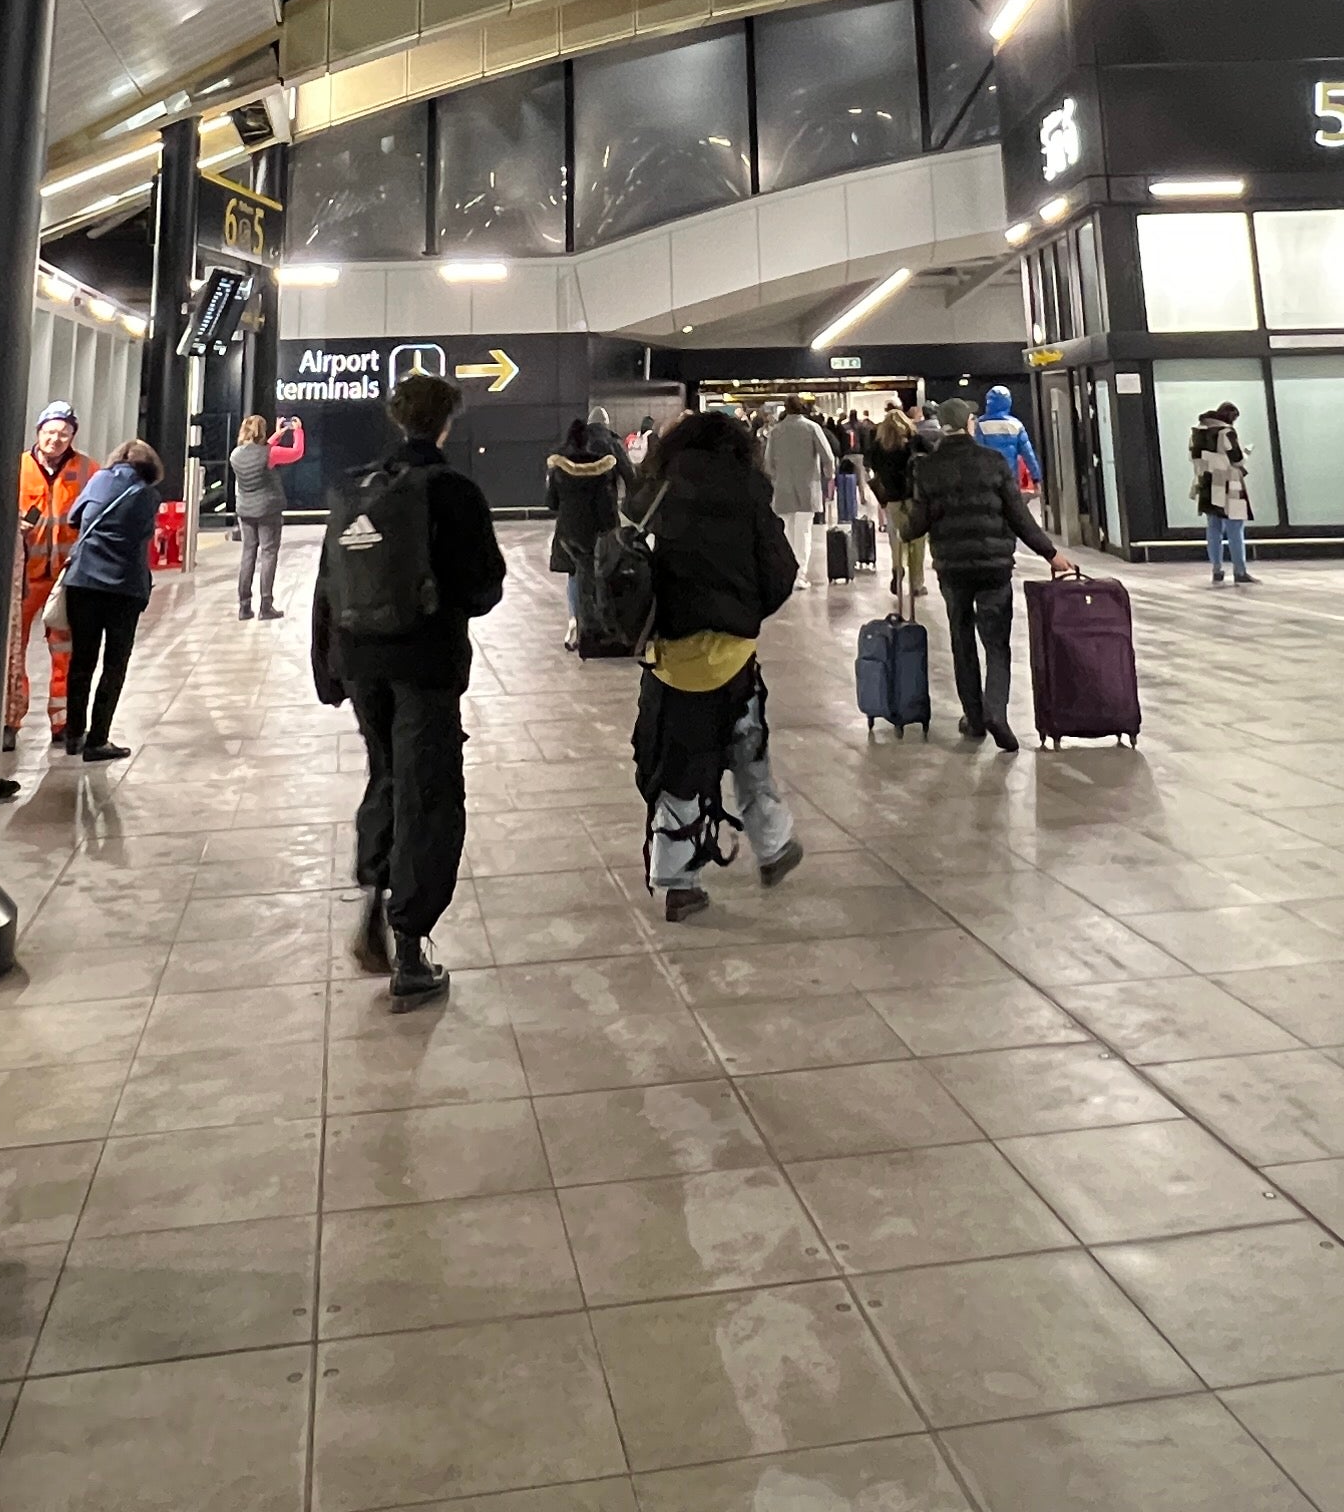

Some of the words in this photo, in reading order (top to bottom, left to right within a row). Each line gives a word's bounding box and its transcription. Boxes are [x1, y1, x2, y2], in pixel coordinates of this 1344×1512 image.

[225, 198, 239, 247] 6
[252, 208, 265, 255] 5
[299, 349, 380, 377] Airport
[276, 375, 380, 400] terminals
